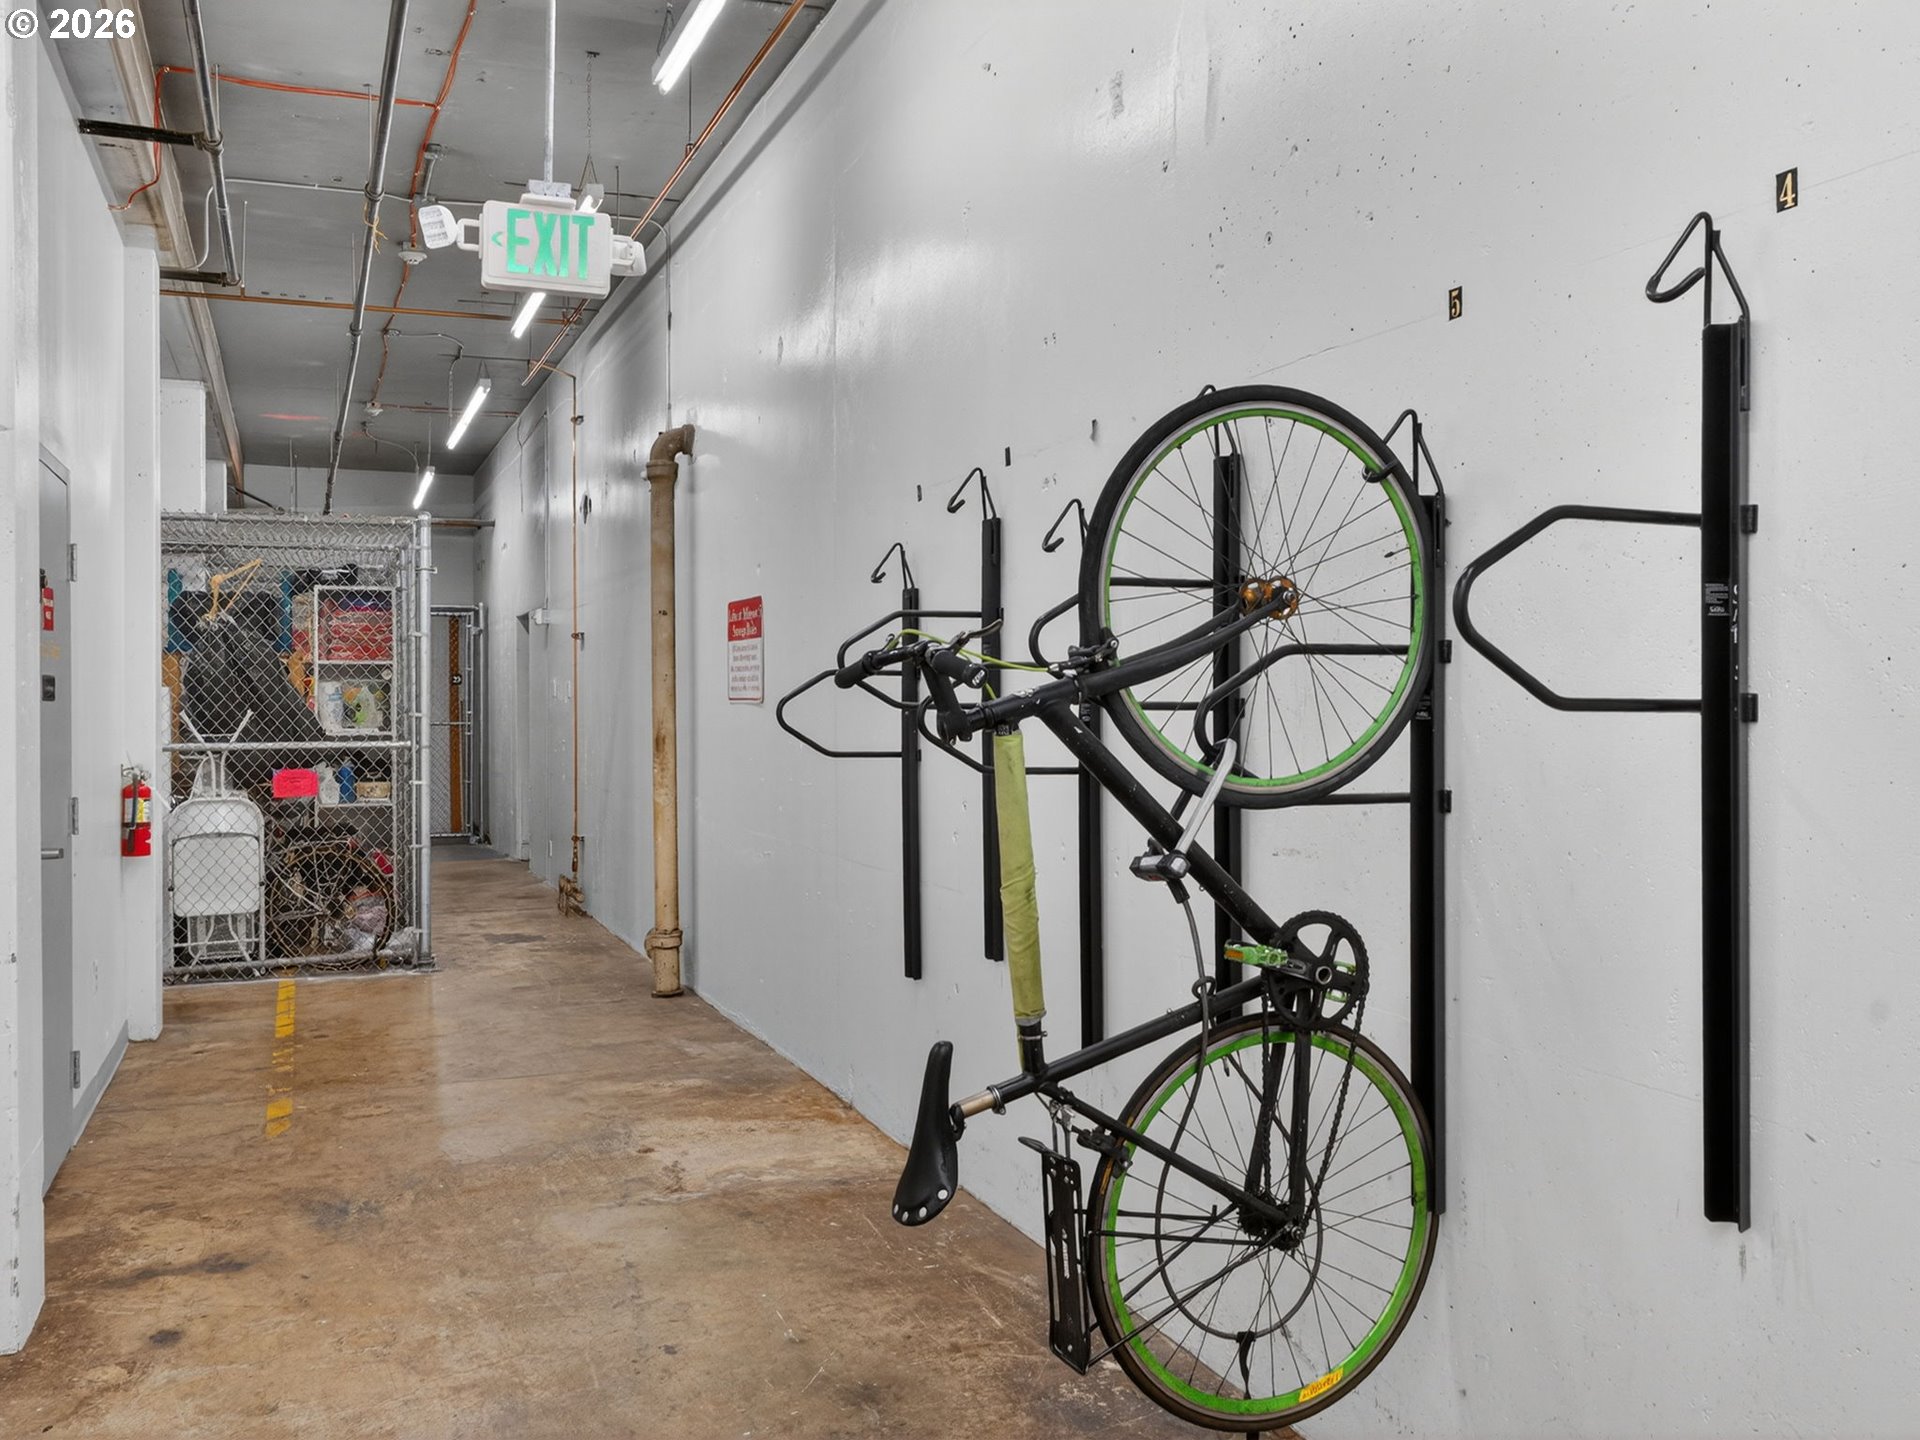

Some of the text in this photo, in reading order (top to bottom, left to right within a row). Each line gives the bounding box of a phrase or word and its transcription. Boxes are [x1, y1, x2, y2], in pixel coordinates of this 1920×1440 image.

[1780, 172, 1796, 208] 4
[507, 208, 595, 280] EXIT
[1451, 290, 1460, 317] 5
